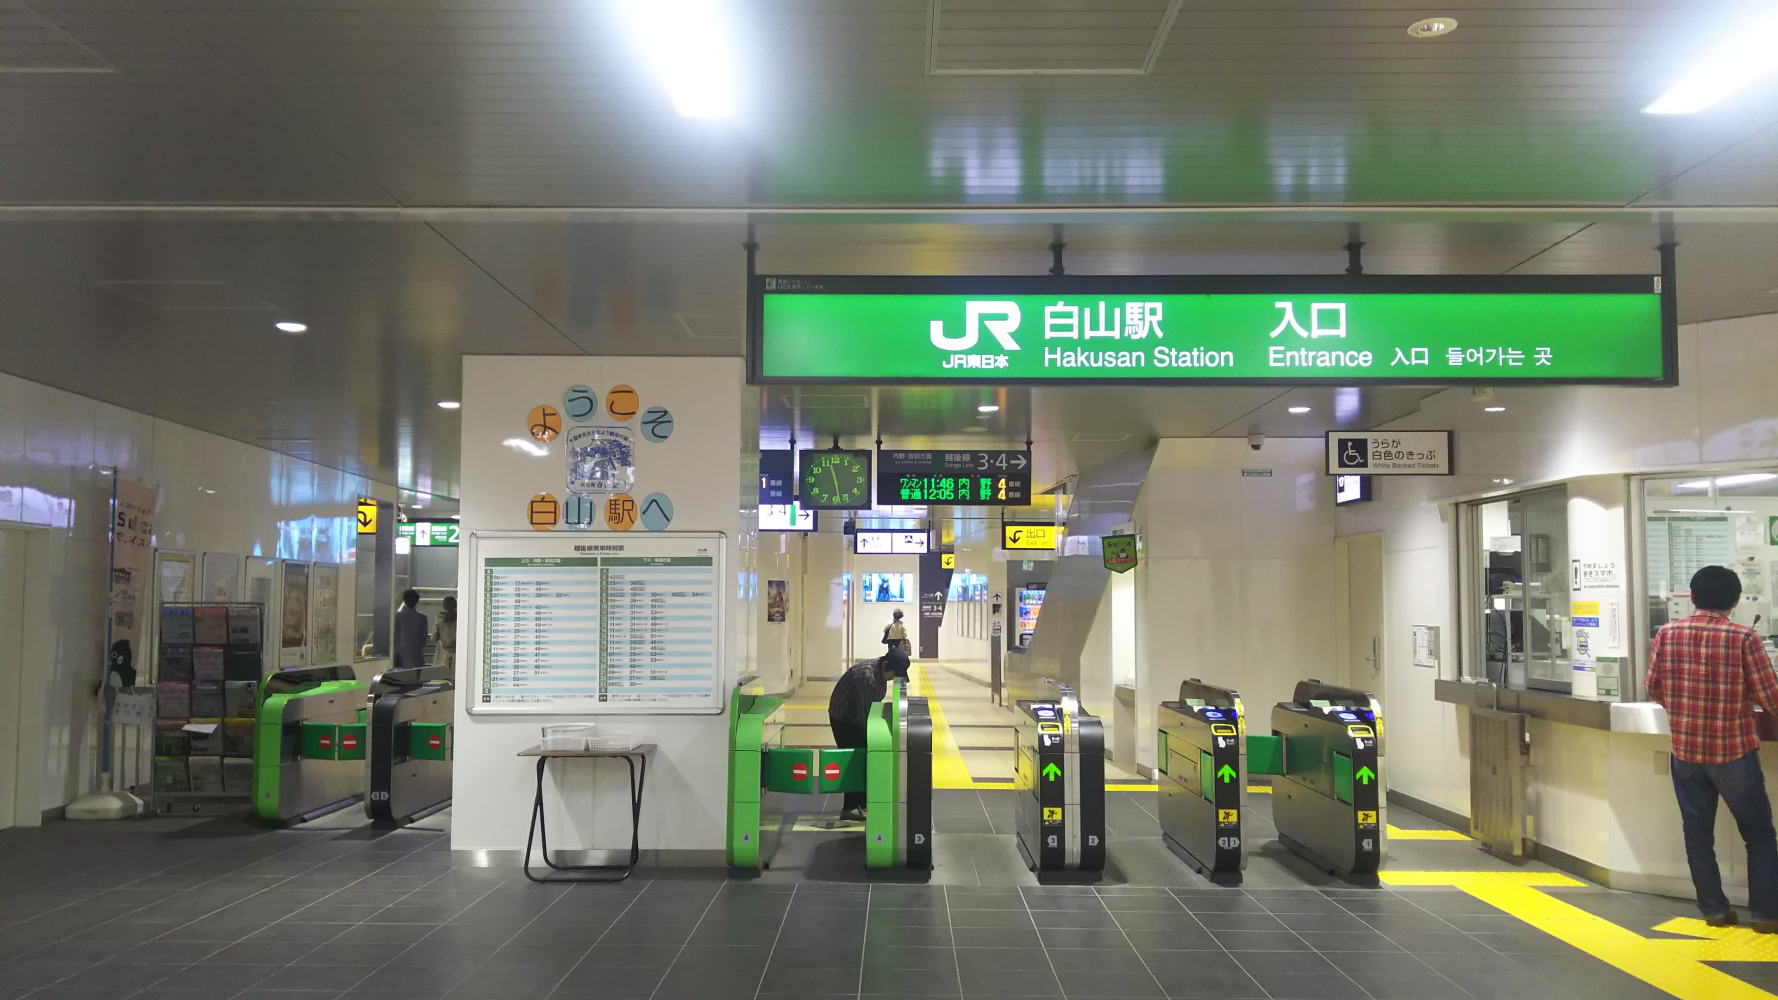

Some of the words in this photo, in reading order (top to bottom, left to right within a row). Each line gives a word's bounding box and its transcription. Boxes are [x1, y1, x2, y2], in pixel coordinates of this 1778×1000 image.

[929, 300, 1022, 351] JR
[1044, 301, 1164, 340] 白山駅
[1269, 301, 1347, 339] 入口
[942, 354, 1010, 369] JR東日本
[1044, 347, 1145, 368] Hakusan
[1153, 347, 1235, 368] Station
[1268, 347, 1373, 368] Entrance
[1390, 347, 1429, 366] 入口
[1445, 347, 1526, 367] 들어가는
[1534, 347, 1553, 367] 곳
[1371, 438, 1401, 449] うらが
[944, 453, 971, 462] 越後線
[1372, 450, 1437, 461] 白色のきっぷ
[761, 477, 767, 489] 1
[900, 479, 922, 489] ワンマン
[923, 478, 954, 489] 11:46
[997, 478, 1007, 489] 4
[900, 489, 922, 500] 普通
[923, 489, 954, 500] 12:05
[997, 489, 1007, 500] 4
[530, 496, 671, 525] 白山駅へ
[448, 525, 460, 543] 2
[1026, 529, 1045, 539] 出口
[744, 834, 749, 842] 4
[876, 834, 882, 842] 4
[916, 835, 922, 843] 3
